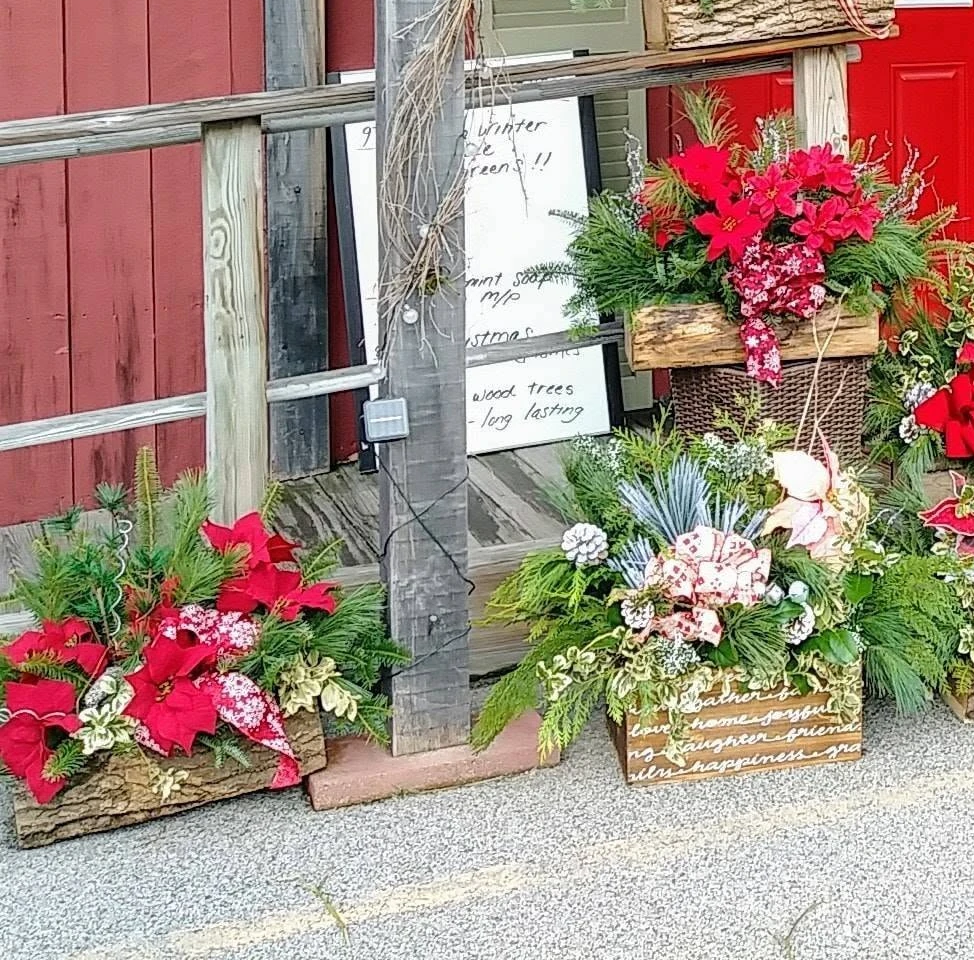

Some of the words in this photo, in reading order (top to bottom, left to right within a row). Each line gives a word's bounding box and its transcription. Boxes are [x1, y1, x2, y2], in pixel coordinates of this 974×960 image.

[472, 384, 517, 401] wood
[527, 381, 574, 396] trees
[524, 402, 584, 424] lasting
